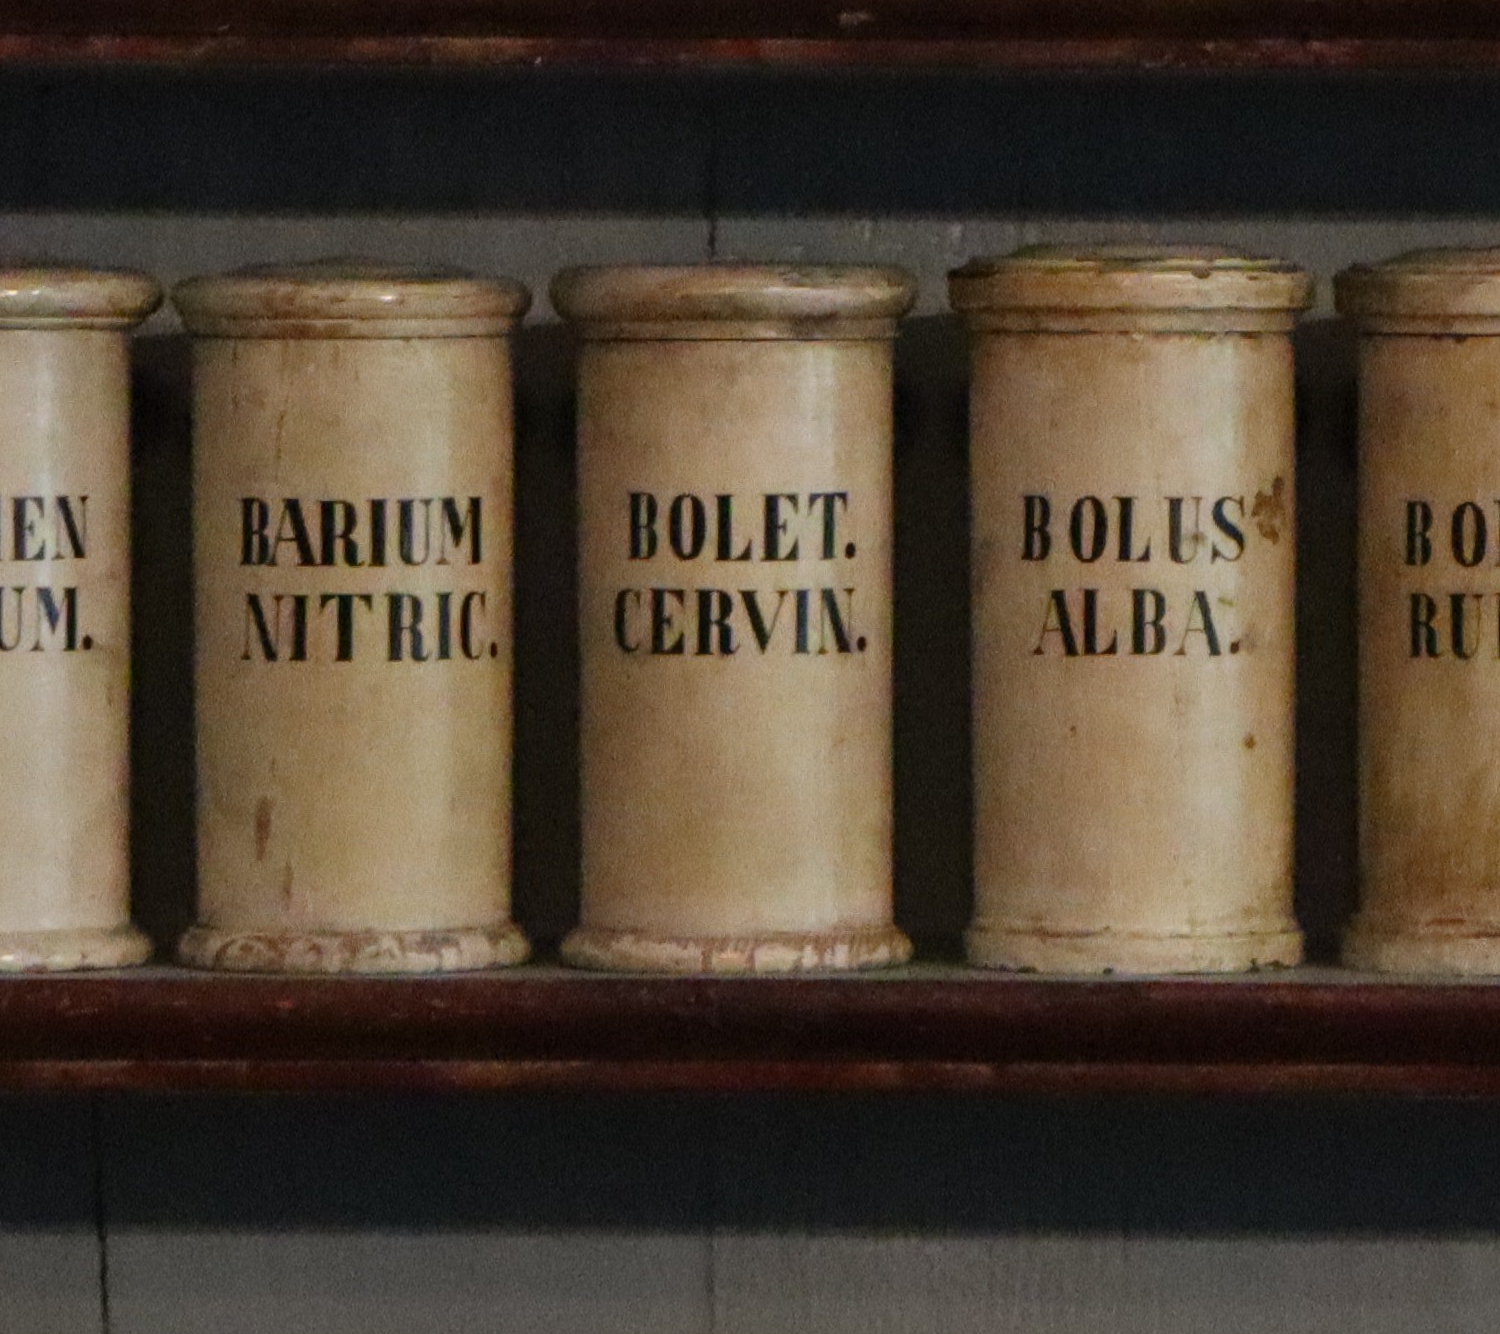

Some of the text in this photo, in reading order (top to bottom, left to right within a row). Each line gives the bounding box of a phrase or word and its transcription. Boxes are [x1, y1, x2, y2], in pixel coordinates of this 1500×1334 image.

[239, 497, 483, 567] BARIUM
[628, 492, 856, 562] BOLET.
[1021, 496, 1247, 564] BOLUS
[241, 591, 499, 662] NITRIC.
[614, 588, 867, 656] CERVIN.
[1033, 590, 1241, 657] ALBA.
